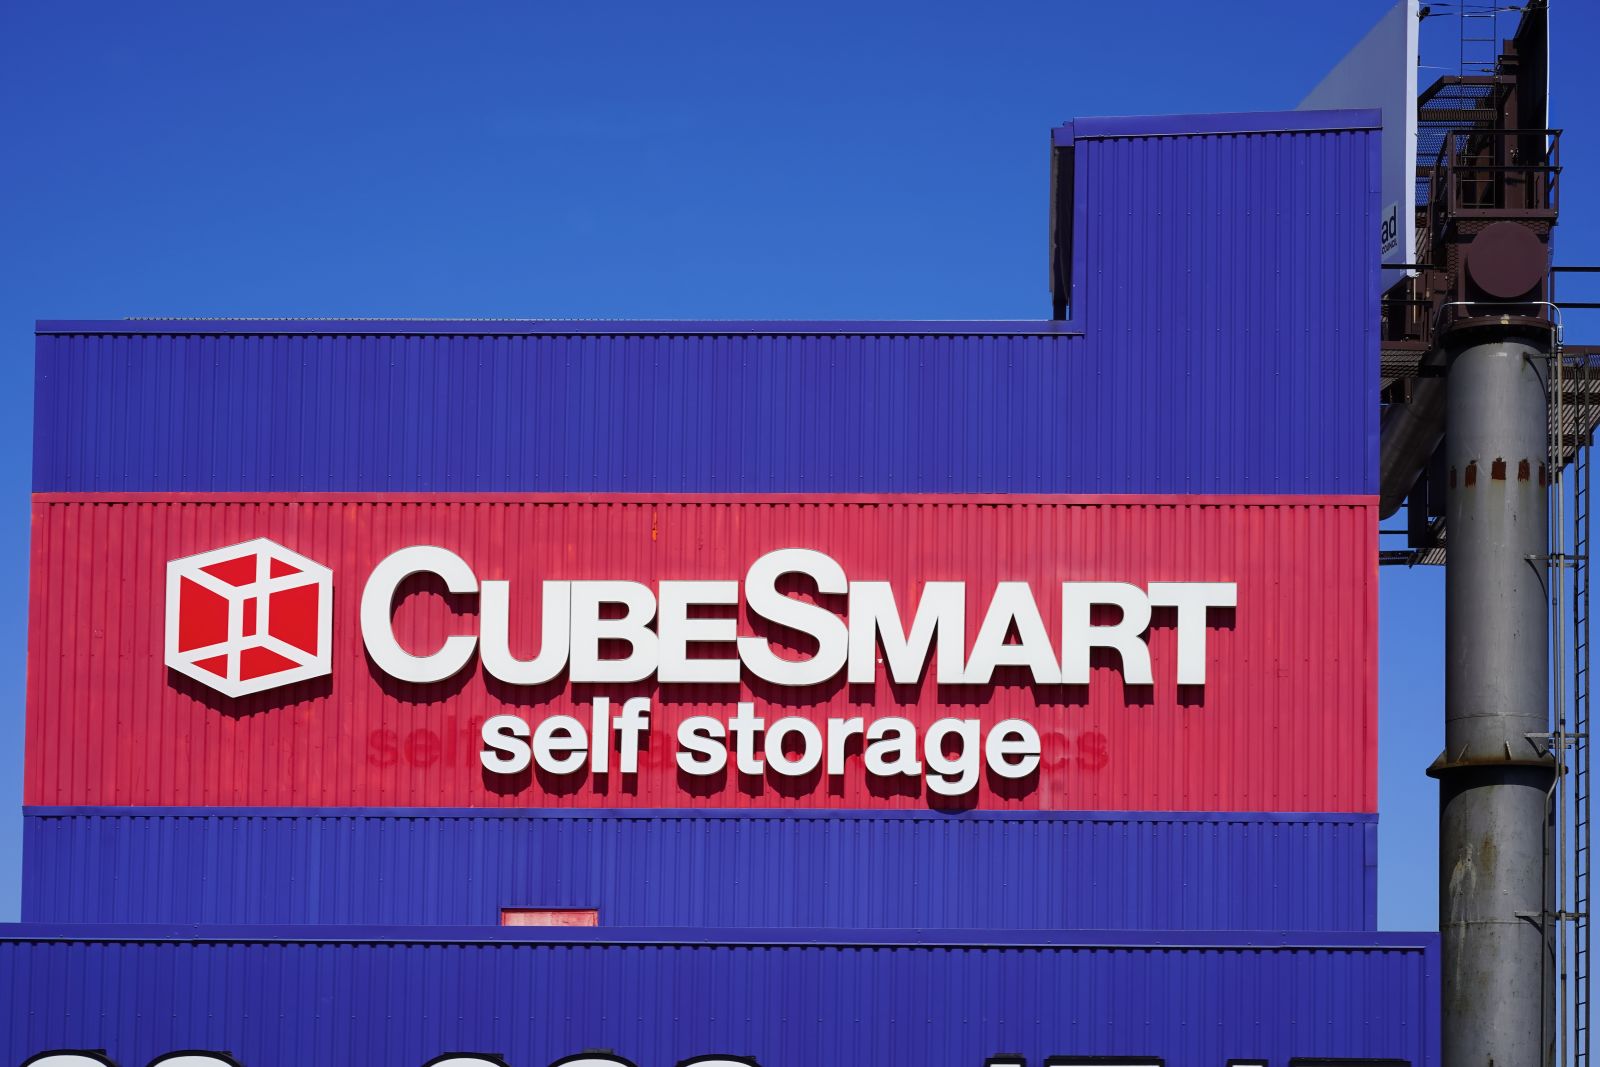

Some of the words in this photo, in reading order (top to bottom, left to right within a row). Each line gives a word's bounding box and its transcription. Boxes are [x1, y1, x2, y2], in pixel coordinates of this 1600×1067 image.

[1382, 205, 1397, 244] ad
[360, 546, 1238, 686] CUBESMART
[480, 697, 651, 776] self
[676, 702, 1041, 797] storage
